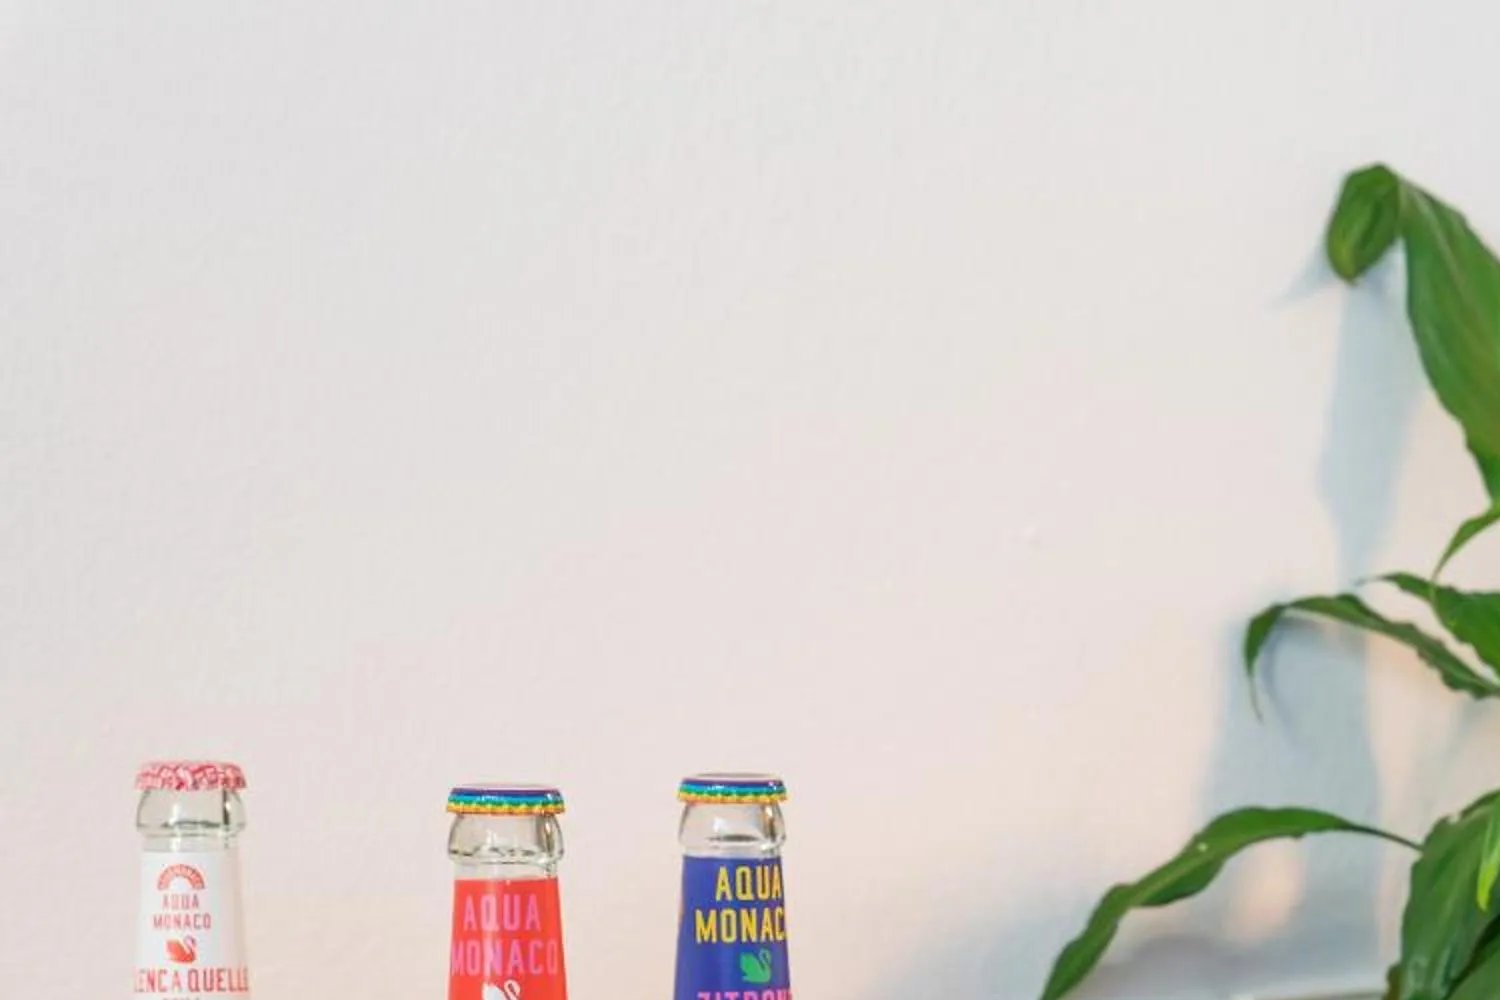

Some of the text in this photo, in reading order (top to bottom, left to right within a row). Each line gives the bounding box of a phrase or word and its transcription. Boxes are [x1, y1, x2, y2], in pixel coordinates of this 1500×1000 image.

[162, 894, 199, 910] AQUA
[715, 865, 783, 902] AQUA
[153, 913, 212, 930] MONACO
[463, 893, 541, 932] AQUA
[451, 938, 558, 977] MONACO
